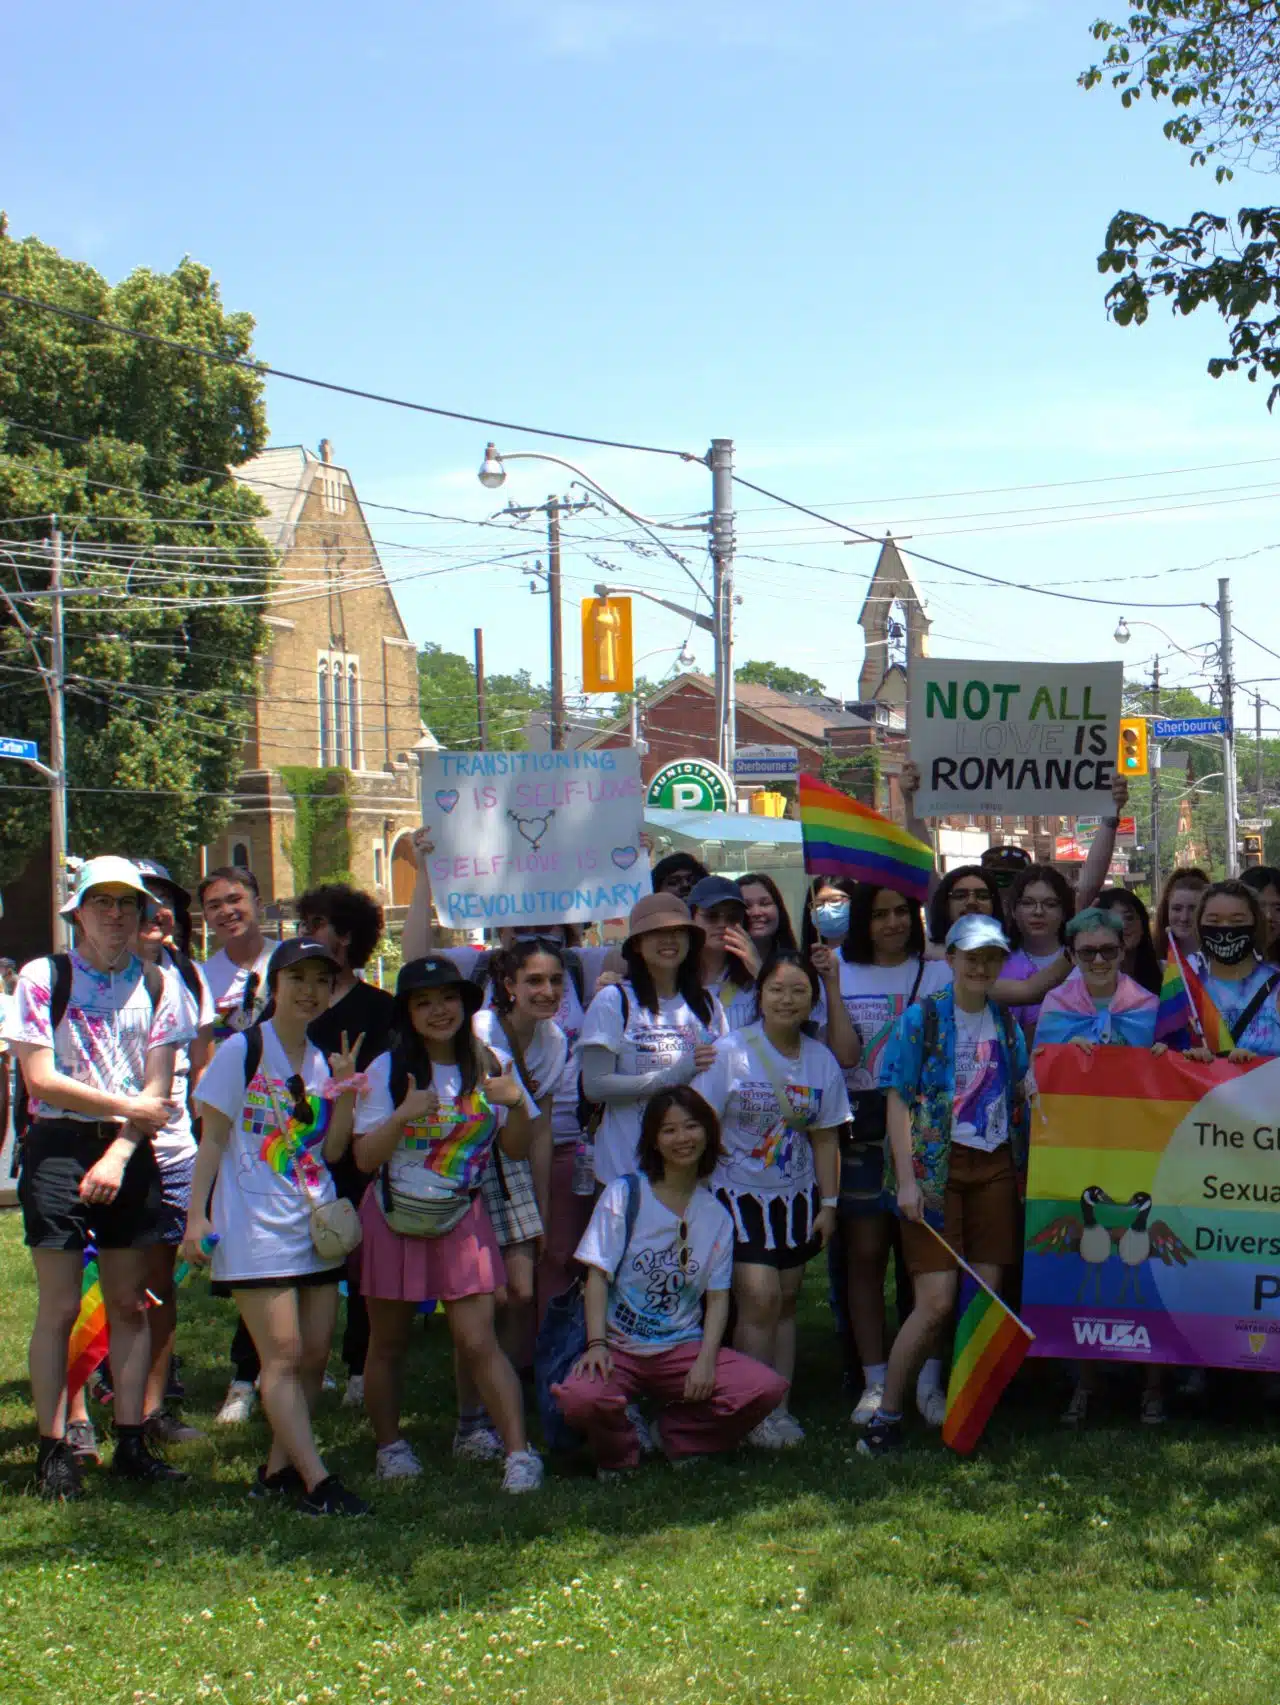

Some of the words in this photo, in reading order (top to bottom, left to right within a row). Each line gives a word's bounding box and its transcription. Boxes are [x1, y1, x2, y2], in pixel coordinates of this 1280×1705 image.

[926, 680, 1020, 721] NOT
[1029, 685, 1107, 721] ALL
[955, 721, 1065, 755] LOVE
[1074, 724, 1108, 756] IS
[1157, 719, 1222, 734] Sherbourne
[438, 751, 617, 777] TRANSITIONING
[736, 760, 787, 773] Sherbourne
[931, 756, 1115, 791] ROMANCE
[474, 786, 498, 811] IS
[516, 777, 639, 808] SELF-LOVE
[652, 764, 721, 798] MUNICIPAL
[672, 783, 703, 810] P
[432, 853, 561, 881] SELF-LOVE
[577, 848, 598, 870] IS
[447, 882, 643, 921] REVOLUTIONARY
[1193, 1121, 1244, 1149] The
[646, 1268, 686, 1294] 20
[641, 1292, 681, 1316] 23
[1072, 1321, 1151, 1349] WUSA
